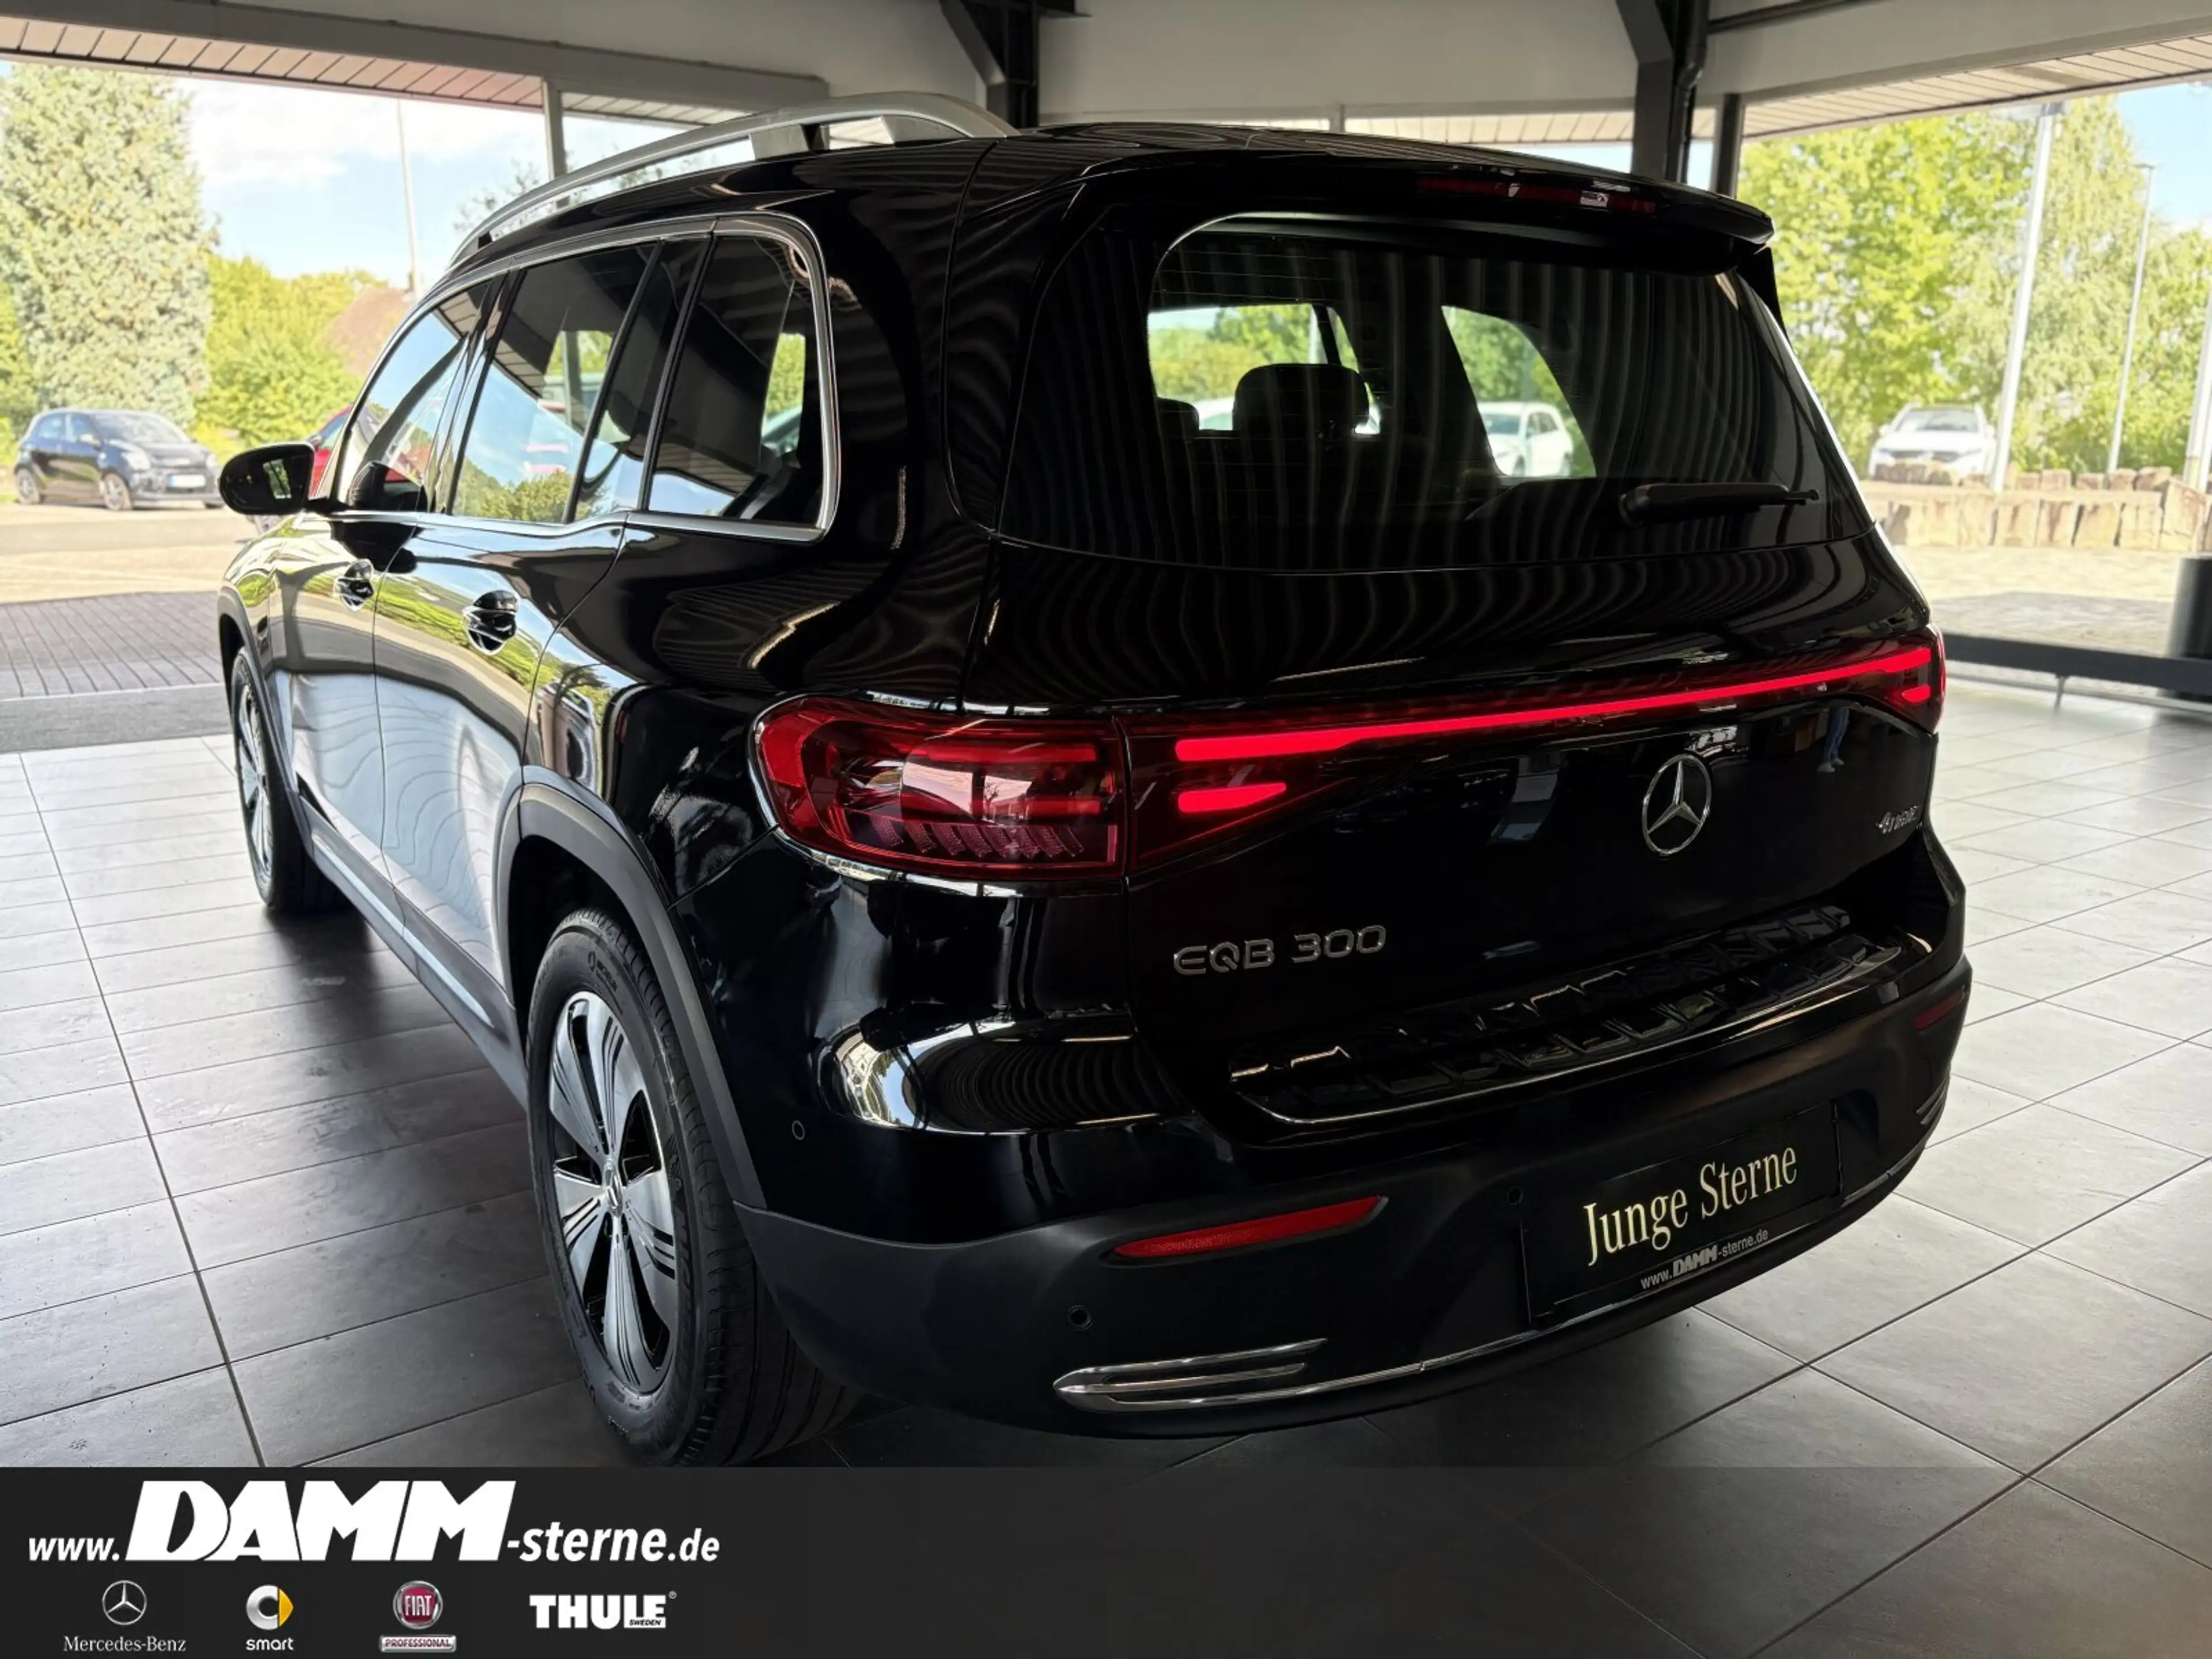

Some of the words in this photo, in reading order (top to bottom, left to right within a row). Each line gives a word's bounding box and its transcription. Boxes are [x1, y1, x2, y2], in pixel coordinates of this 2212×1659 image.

[1173, 938, 1275, 975] EQB
[1292, 925, 1386, 963] 300
[1584, 1189, 1688, 1267] Junge
[1700, 1147, 1797, 1219] Sterne
[1641, 1229, 1768, 1289] www.DAMM-sterne.de
